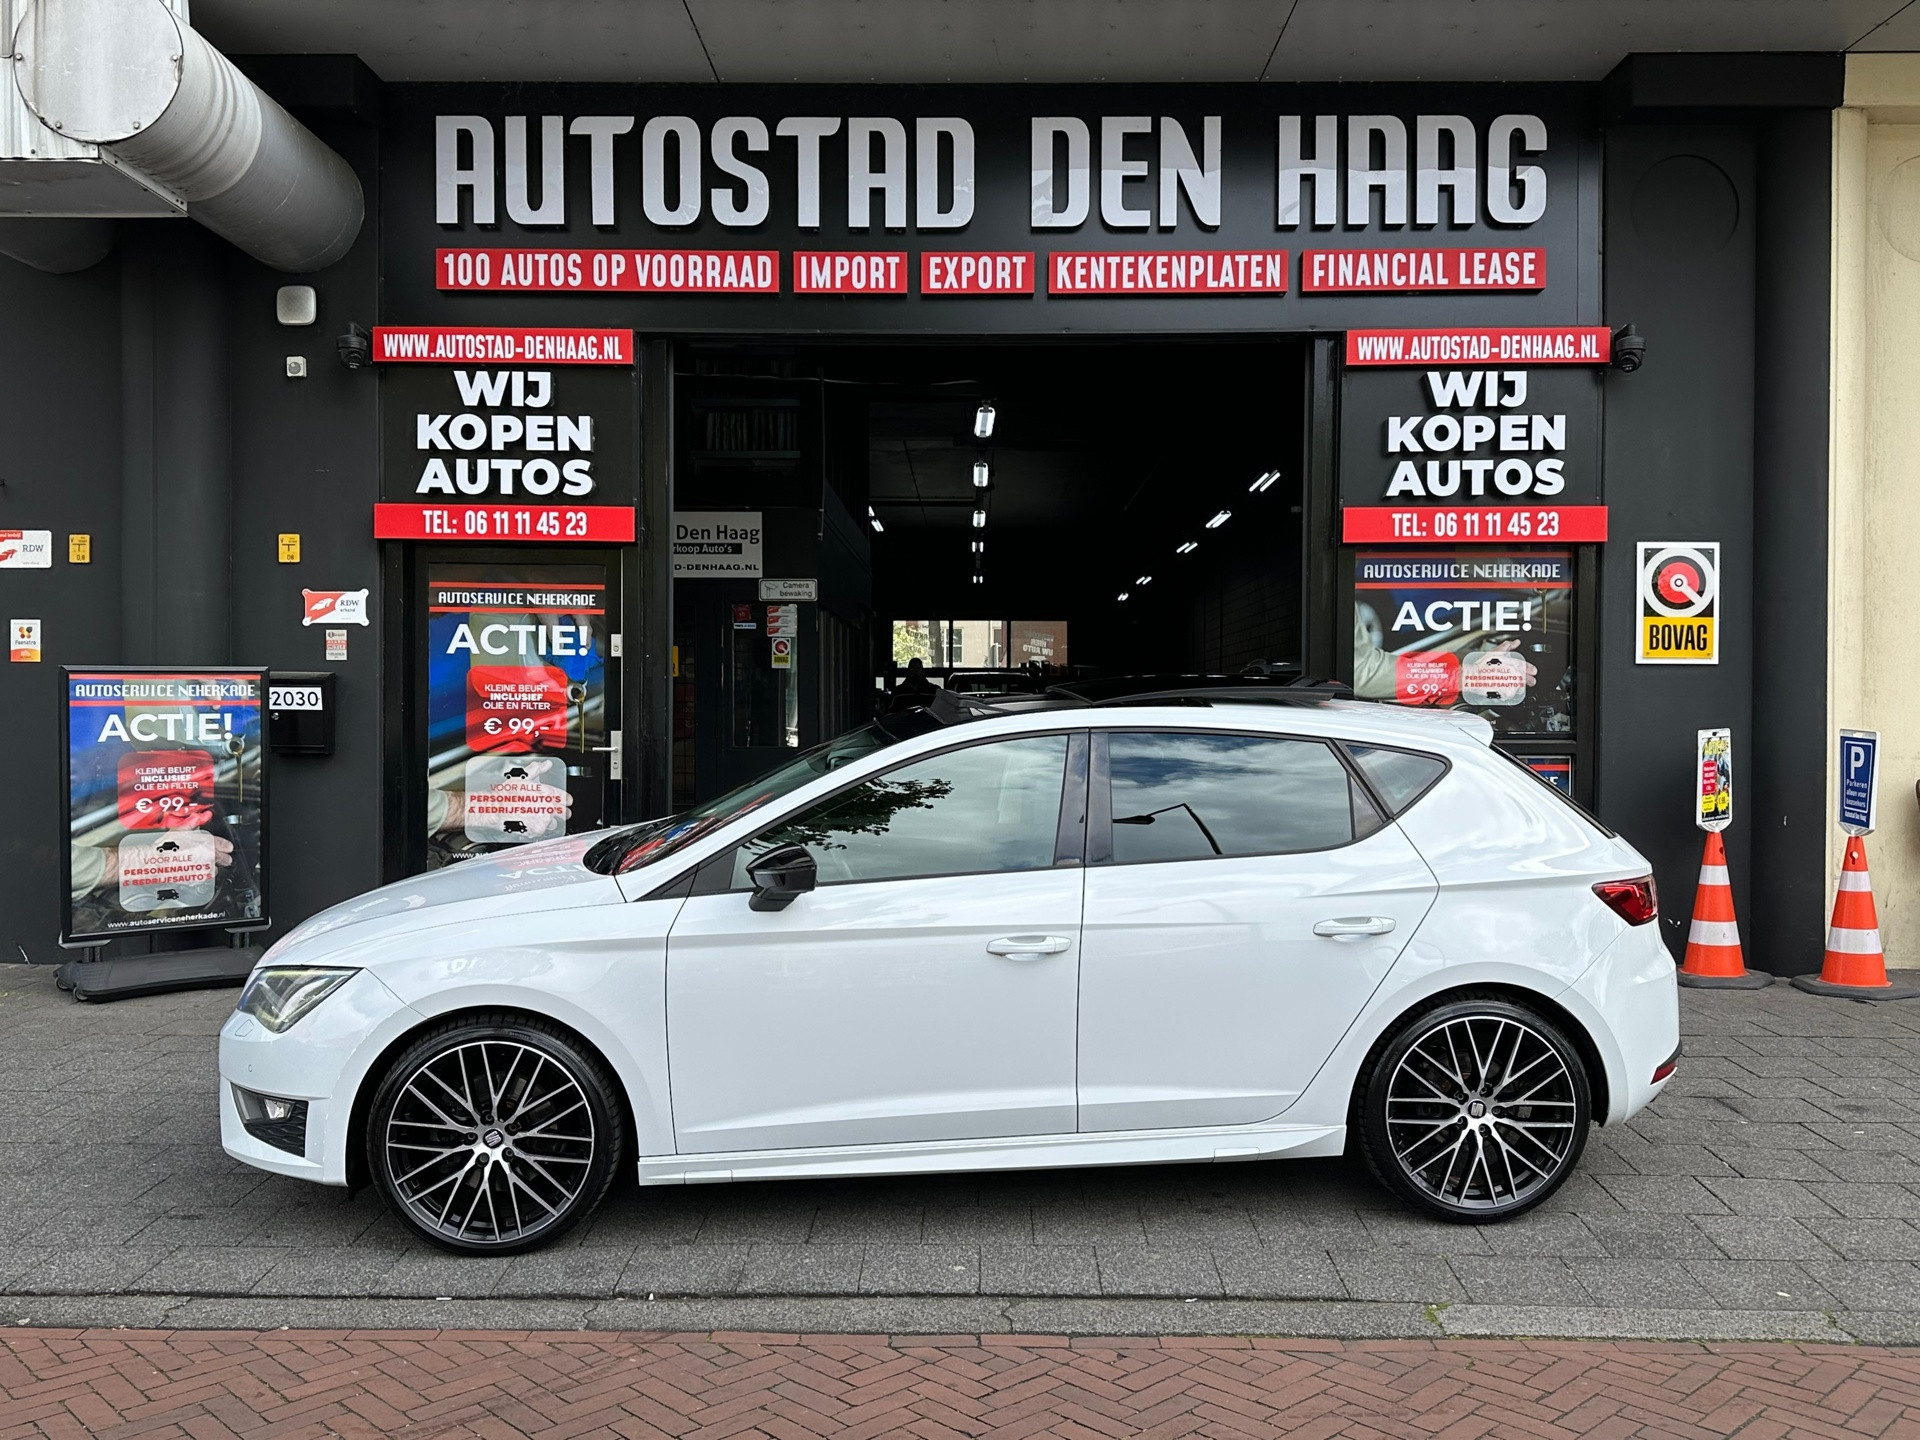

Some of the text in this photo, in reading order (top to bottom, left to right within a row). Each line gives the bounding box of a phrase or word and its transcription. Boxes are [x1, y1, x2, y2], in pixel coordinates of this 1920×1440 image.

[435, 114, 1548, 228] AUTOSTAD DEN HAAG
[443, 252, 773, 289] 100 AUTOS OP VOORRAAD
[800, 255, 901, 290] IMPORT
[929, 255, 1028, 290] EXPORT
[1056, 254, 1281, 290] KENTEKENPLATEN
[1312, 251, 1536, 287] FINANCIAL LEASE
[383, 333, 623, 360] WWW.AUTOSTAD-DENHAAG.NL
[1357, 334, 1600, 361] WWW.AUTOSTAD-DENHAAG.NL
[453, 370, 552, 408] WIJ
[1426, 370, 1528, 408] WIJ
[416, 413, 593, 452] KOPEN
[1387, 414, 1567, 453] KOPEN
[415, 458, 593, 496] AUTOS
[1385, 458, 1566, 498] AUTOS
[422, 510, 588, 537] TEL: 06 11 11 45 23
[1391, 511, 1560, 537] TEL: 06 11 11 45 23
[676, 524, 760, 545] Den Haag
[22, 544, 44, 553] RDW
[702, 544, 733, 553] Auto's
[1363, 563, 1561, 579] AUTOSERVICE NEHERKADE
[779, 590, 813, 598] bewaking
[782, 581, 810, 589] Camera
[340, 599, 359, 607] RDW
[438, 591, 596, 606] AUTOSERVICE NEHERKADE
[1391, 600, 1533, 632] ACTIE!
[445, 623, 589, 657] ACTIE!
[1649, 623, 1708, 651] BOVAG
[75, 684, 256, 697] AUTOSERVICE NEHERKADE
[484, 682, 549, 692] KLEINE BEURT
[1406, 683, 1419, 695] €
[270, 690, 319, 707] 2030
[489, 692, 544, 701] INCLUSIEF
[482, 701, 551, 711] OLIE EN FILTER
[97, 712, 233, 743] ACTIE!
[483, 717, 550, 738] € 99,-
[135, 766, 197, 775] KLEINE BEURT
[1850, 745, 1865, 780] P
[133, 783, 155, 791] OLIE
[170, 781, 199, 790] FILTER
[140, 774, 192, 783] INCLUSIEF
[490, 783, 542, 792] VOOR ALLE
[135, 796, 198, 814] € 99,-
[469, 795, 562, 804] PERSONENAUTO'S
[477, 806, 563, 815] BEDRIJFSAUTO'S
[143, 855, 193, 865] VOOR ALLE
[123, 863, 211, 876] PERSONENAUTO'S
[131, 873, 213, 886] BEDRIJFSAUTO'S
[107, 911, 226, 929] www.autoserviceneherkade.nl
